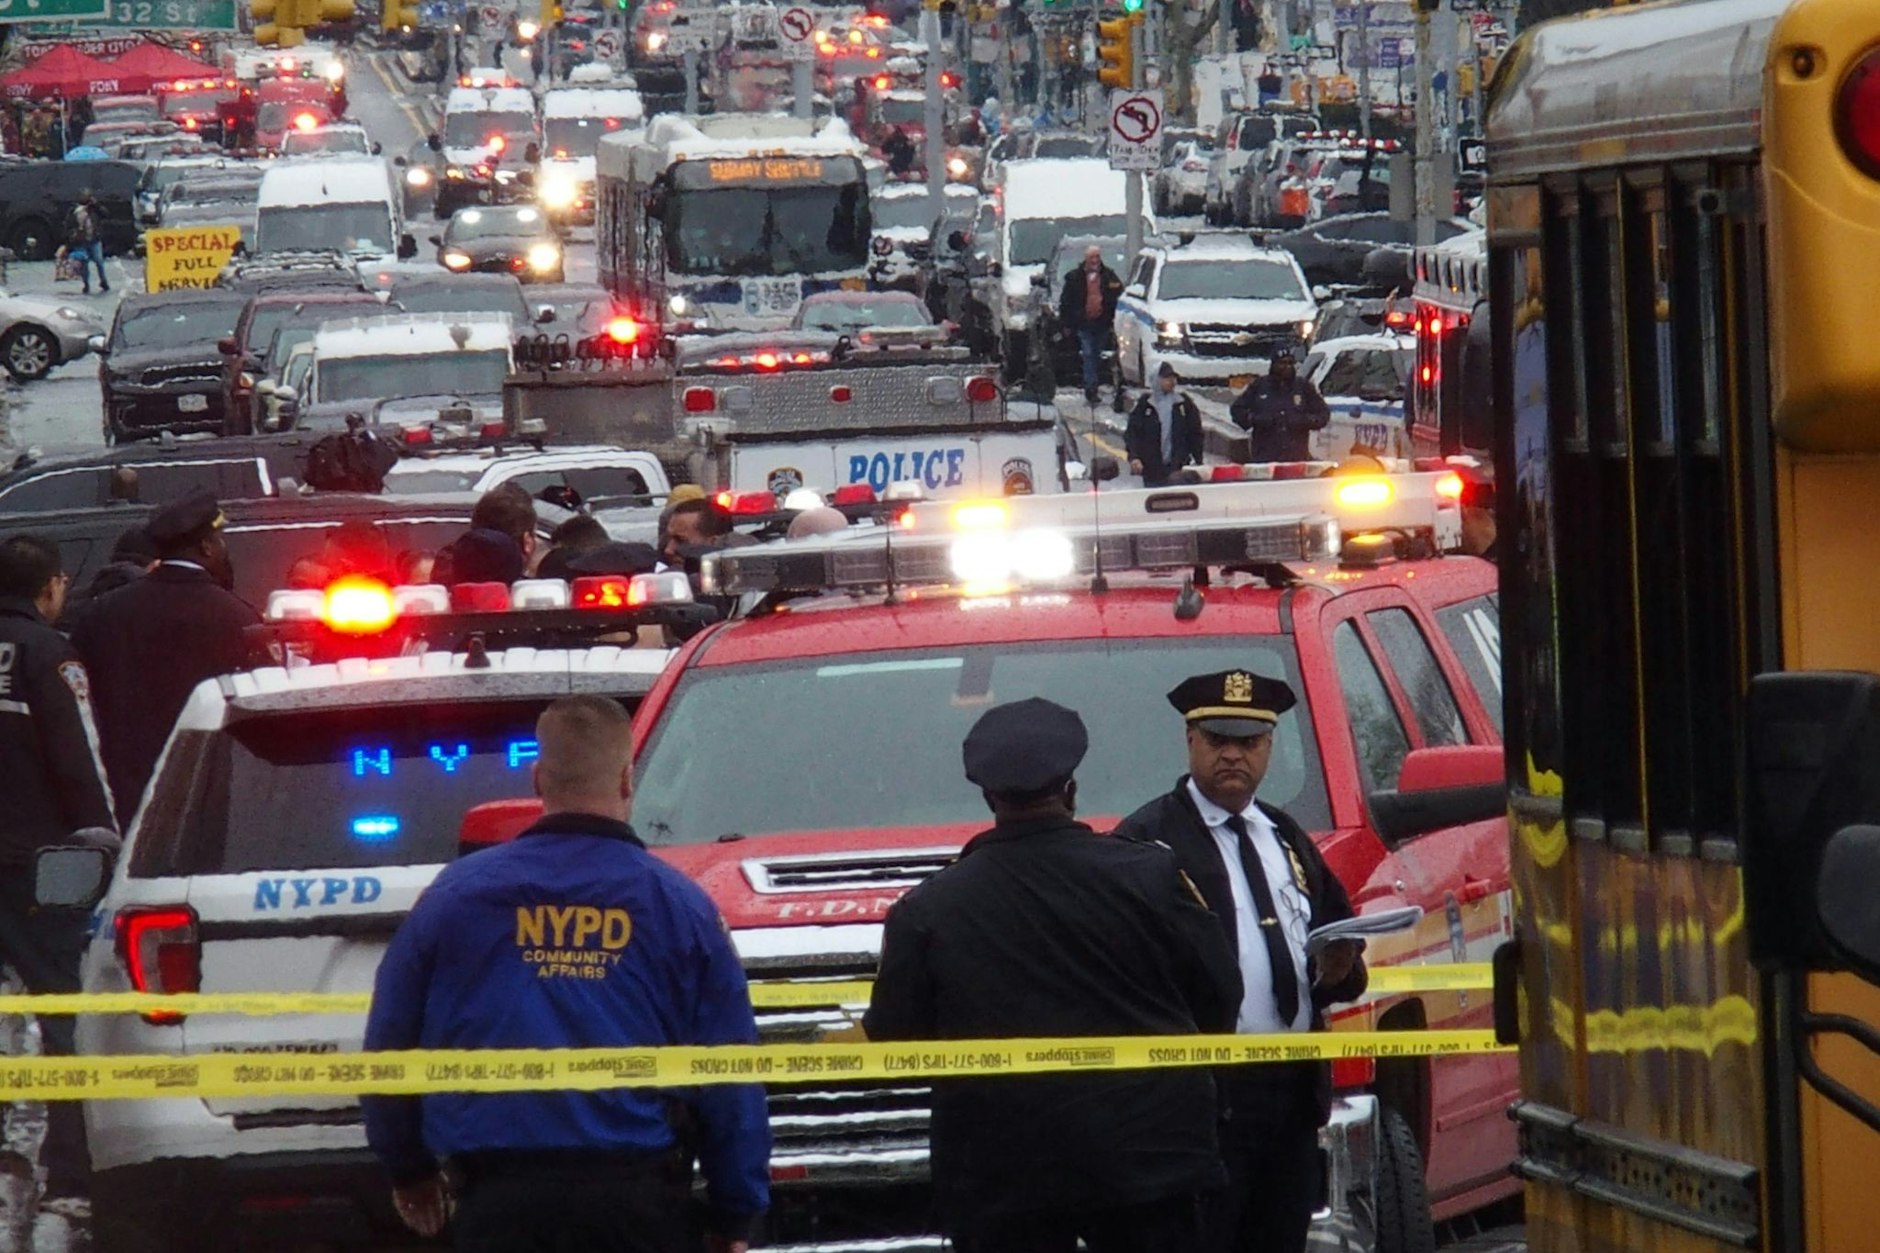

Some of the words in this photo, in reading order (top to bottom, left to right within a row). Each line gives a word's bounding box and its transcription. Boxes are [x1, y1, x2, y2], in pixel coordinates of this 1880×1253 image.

[118, 2, 153, 22] 32
[166, 3, 198, 23] St
[152, 233, 232, 253] SPECIAL
[173, 256, 216, 271] FULL
[849, 449, 965, 493] POLICE
[254, 876, 382, 911] NYPD
[516, 904, 632, 949] NYPD
[522, 949, 622, 966] COMMUNITY
[537, 963, 606, 979] AFFAIRS
[922, 1052, 1011, 1069] 1-800-577-TIPS
[1149, 1048, 1187, 1063] CROSS
[1191, 1048, 1212, 1062] NOT
[1216, 1047, 1232, 1061] DO
[690, 1059, 728, 1075] CROSS
[730, 1058, 753, 1074] NOT
[756, 1057, 773, 1073] DO
[786, 1057, 823, 1073] SCENE
[826, 1055, 863, 1071] CRIME
[884, 1054, 920, 1071] (8477)
